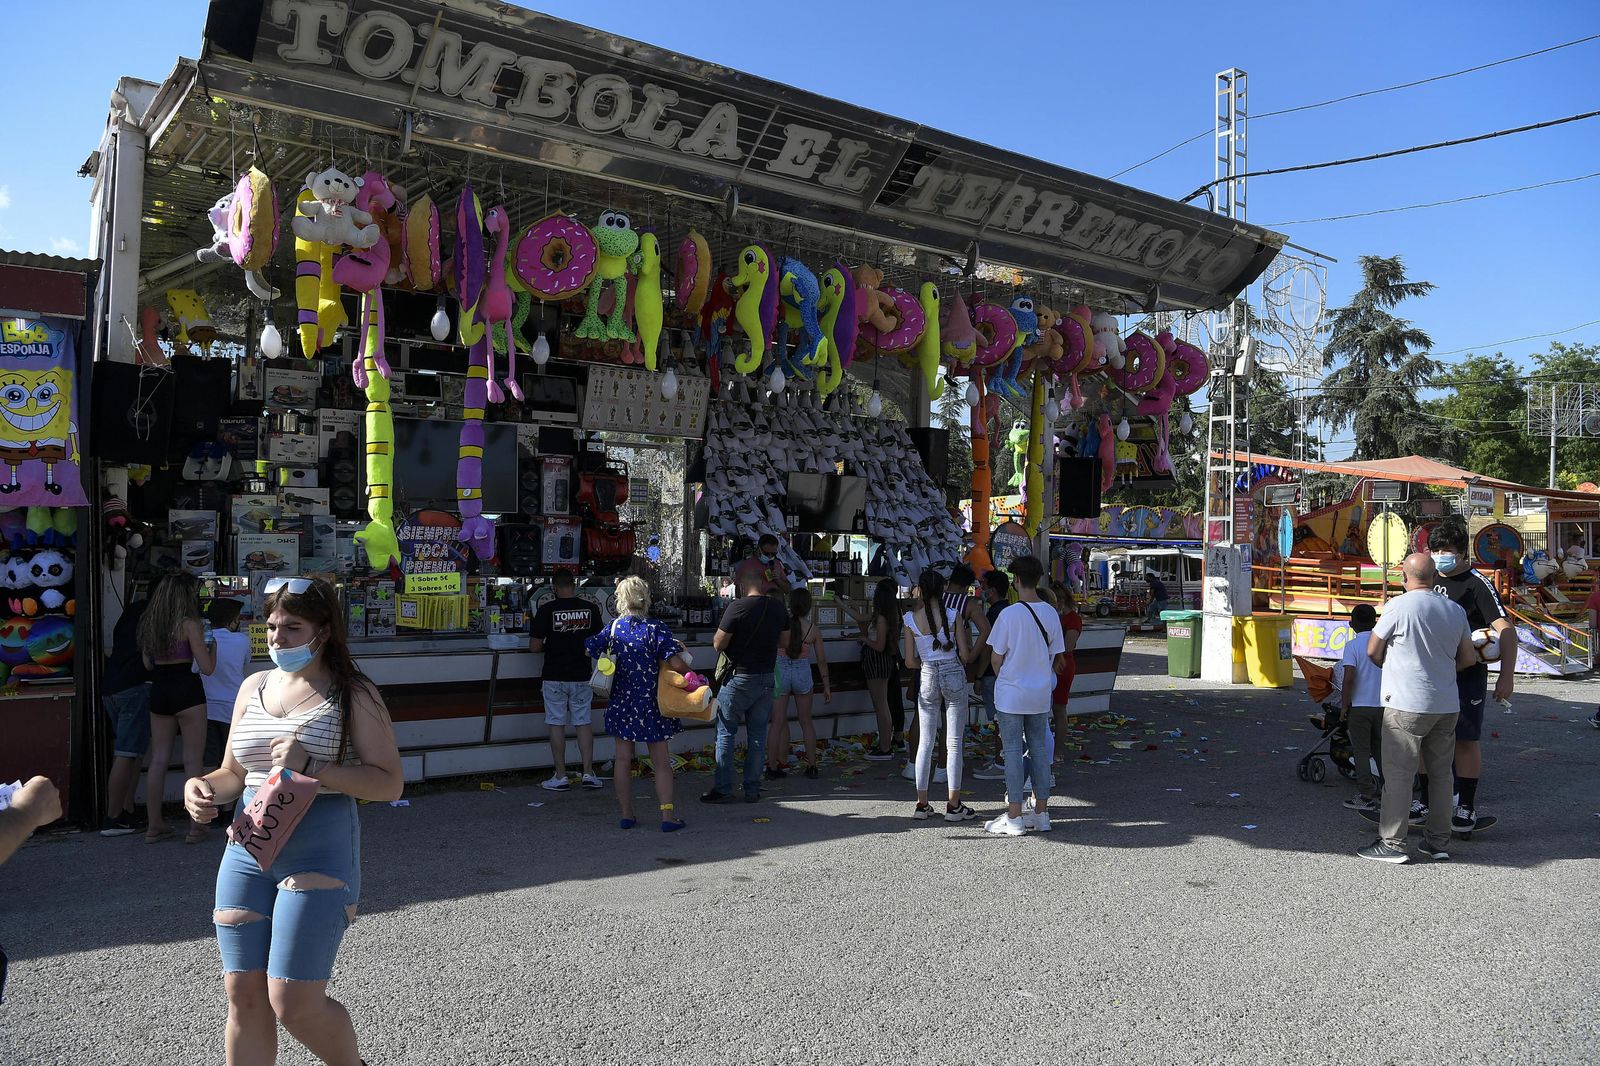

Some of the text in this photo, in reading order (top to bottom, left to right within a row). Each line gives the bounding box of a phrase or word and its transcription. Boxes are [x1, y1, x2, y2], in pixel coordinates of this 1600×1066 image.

[270, 0, 1243, 286] TOMBOLA EL TERREMOTO
[0, 343, 50, 355] ESPONJA
[403, 525, 462, 541] SIEMPRE
[414, 543, 449, 558] TOCA
[405, 560, 457, 573] PREMIO
[554, 611, 590, 621] TOMMY
[1169, 628, 1190, 637] PAPELERA
